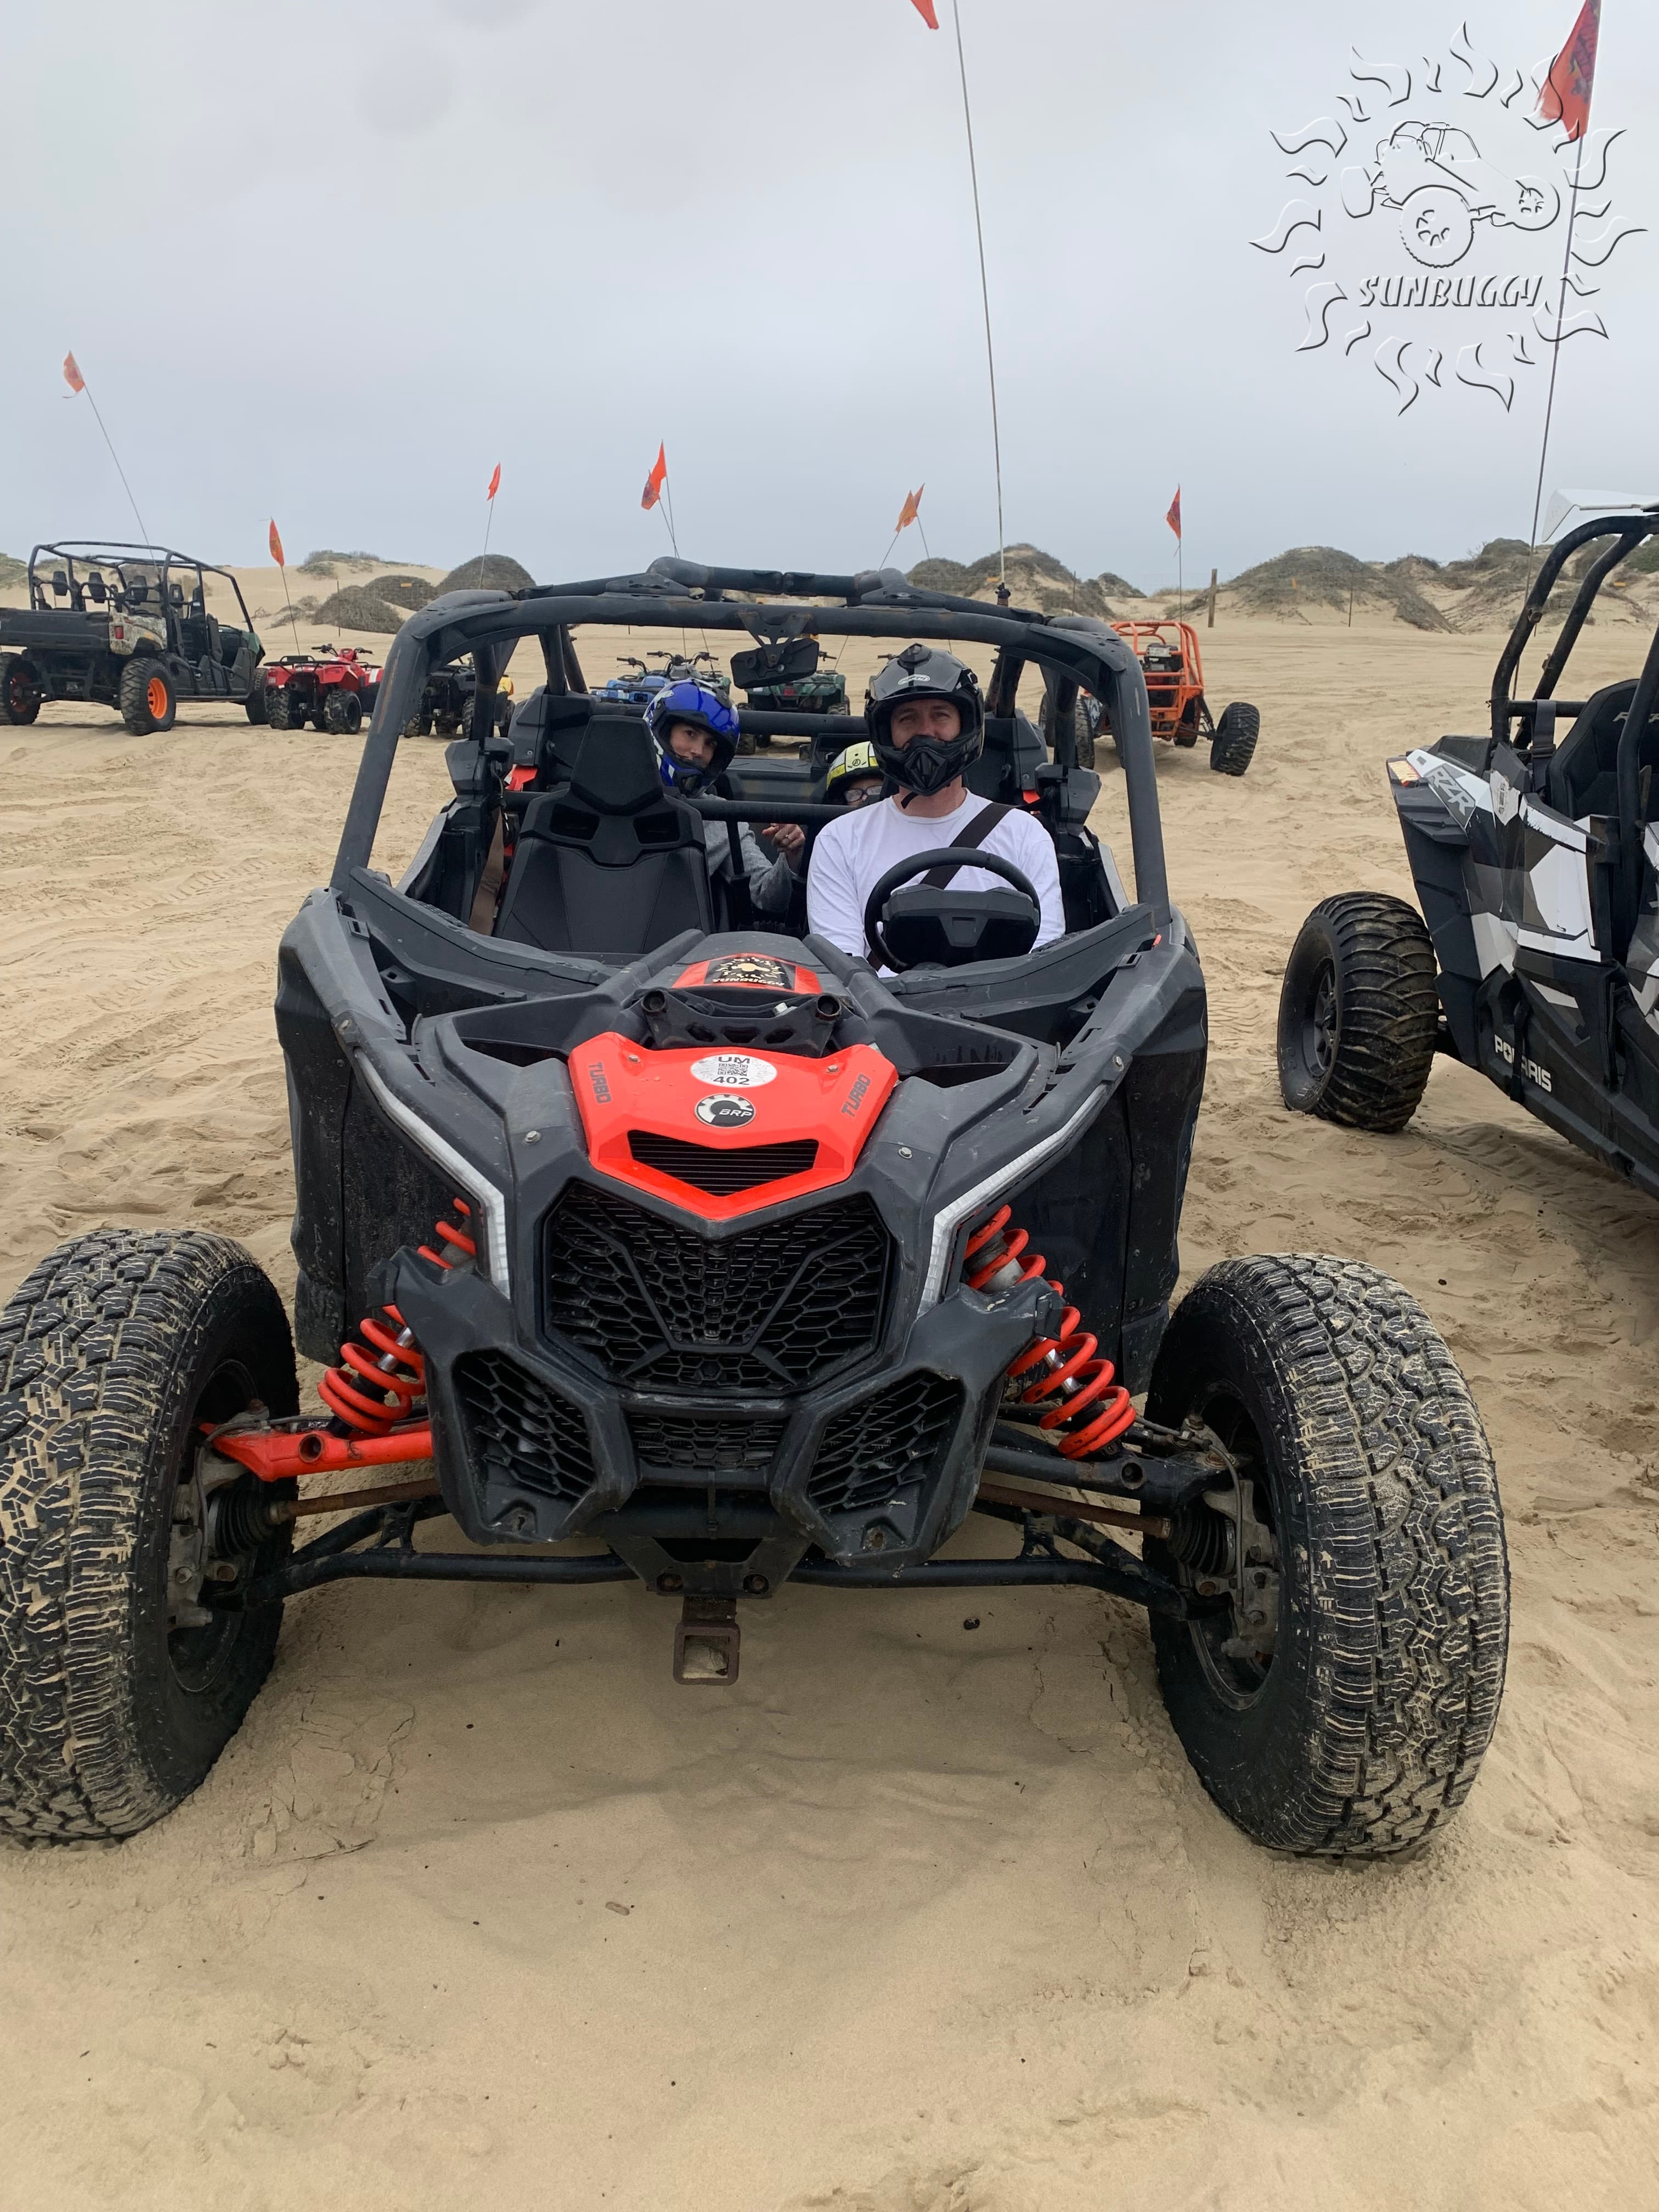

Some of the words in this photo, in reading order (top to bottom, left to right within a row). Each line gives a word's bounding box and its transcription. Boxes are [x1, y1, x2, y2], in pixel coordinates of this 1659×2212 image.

[1427, 766, 1475, 816] RZR
[588, 1062, 611, 1103] TURBO
[713, 1076, 750, 1085] 402
[842, 1074, 871, 1117] TURBO
[719, 1109, 752, 1117] BRP
